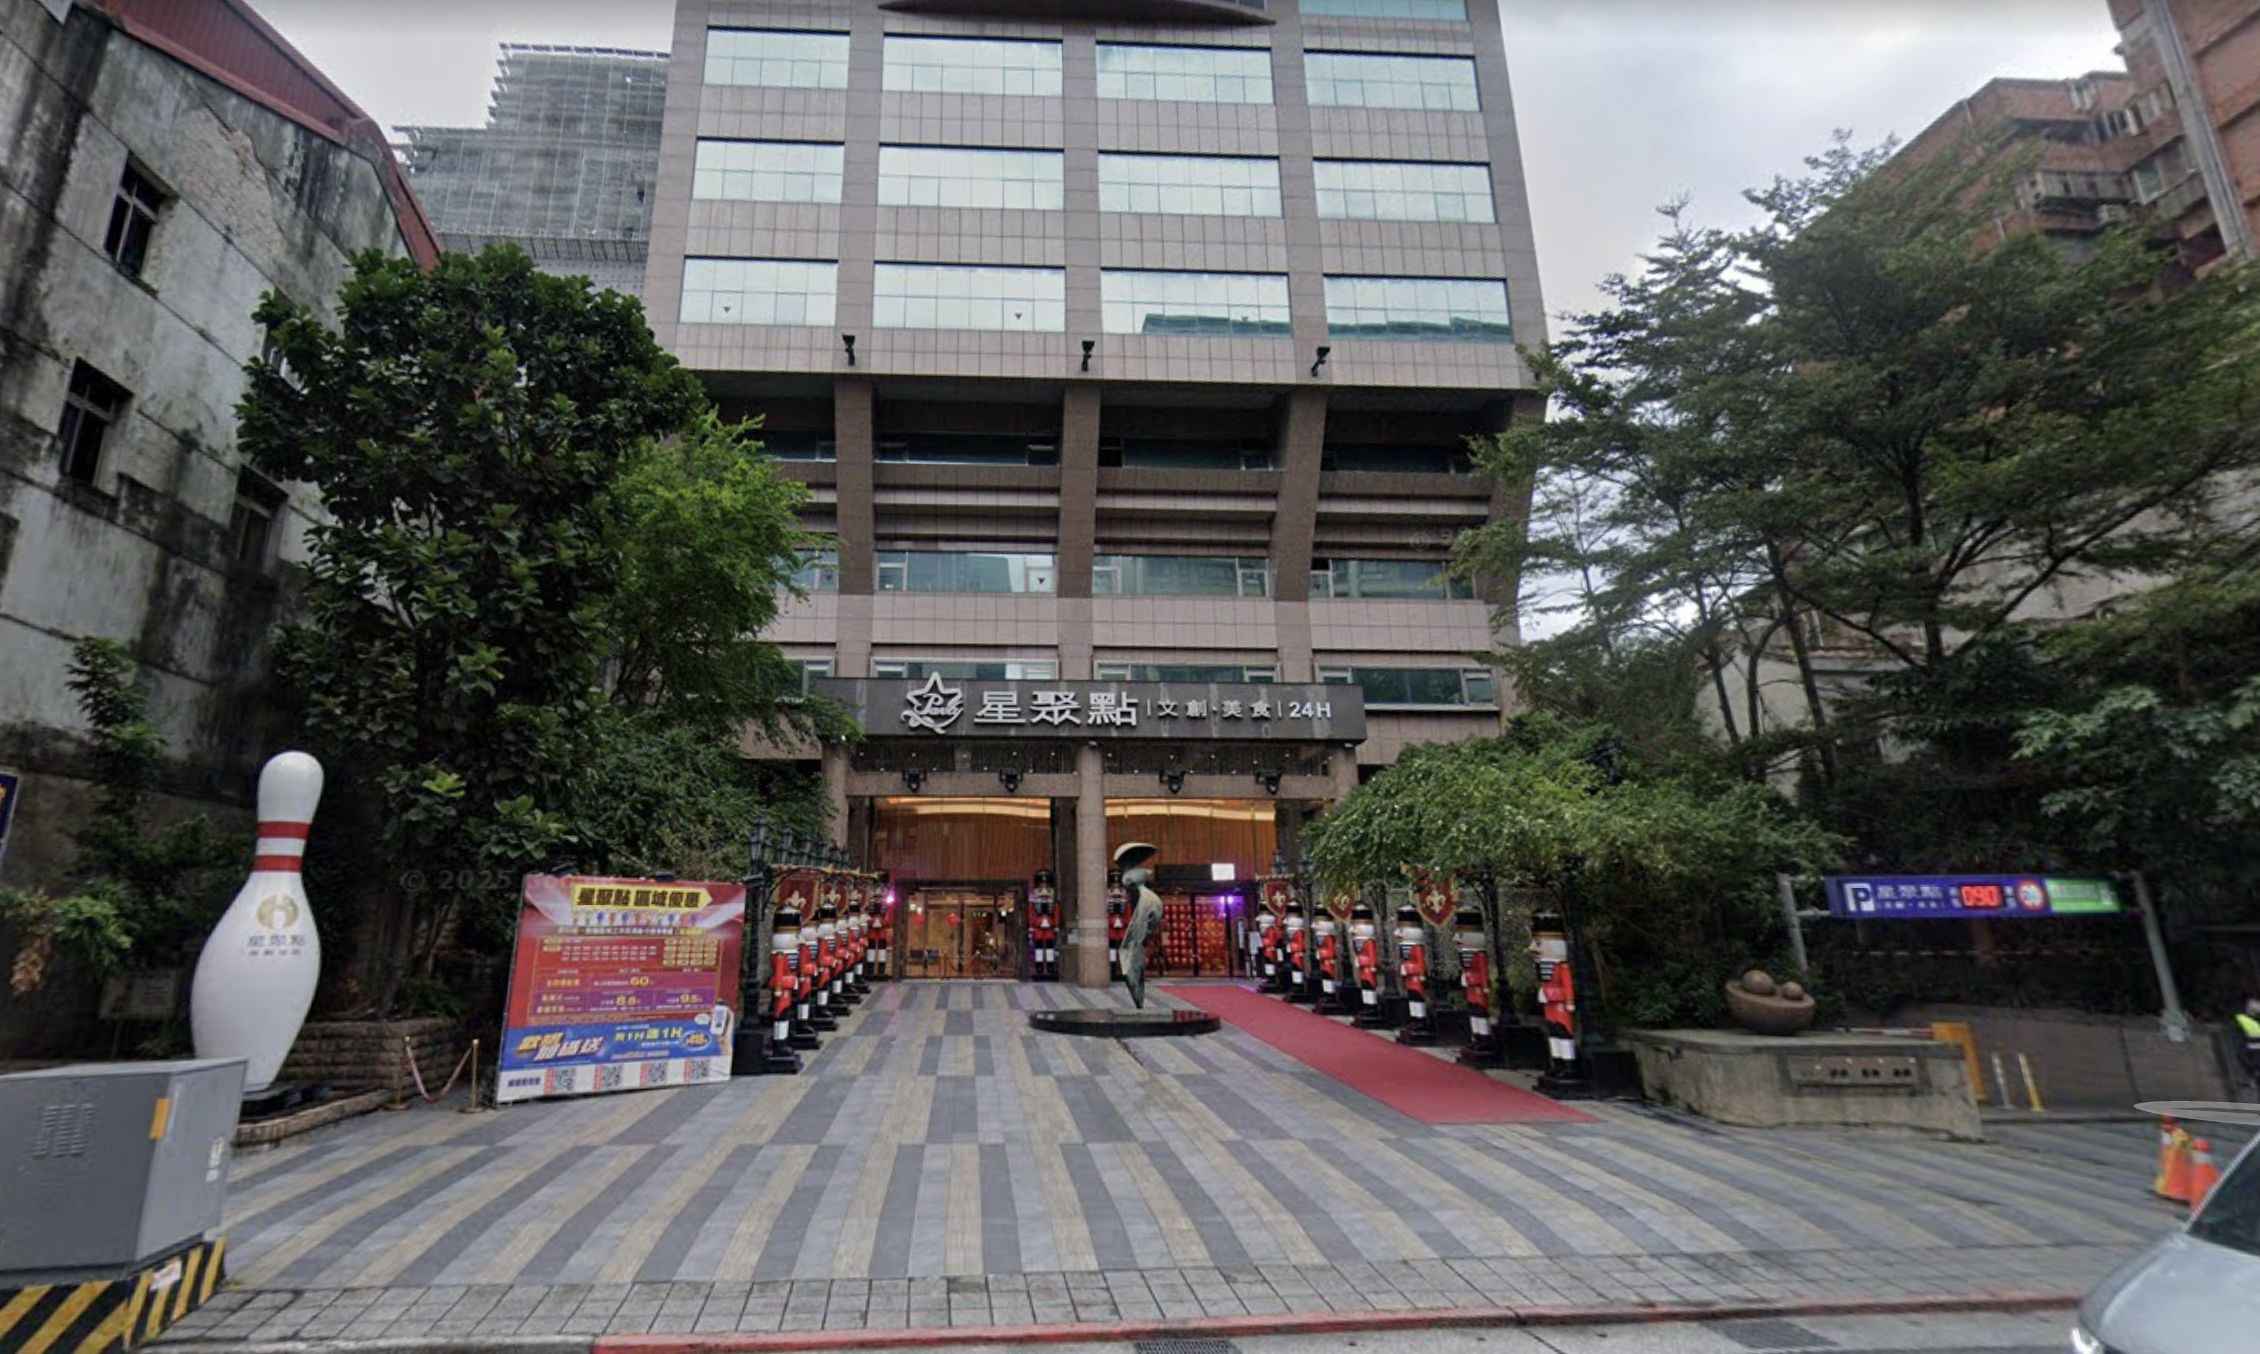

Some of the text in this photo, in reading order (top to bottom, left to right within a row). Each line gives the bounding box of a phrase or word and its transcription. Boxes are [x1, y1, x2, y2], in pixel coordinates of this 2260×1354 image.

[974, 691, 1139, 727] 星聚點
[1289, 701, 1333, 720] 24H
[1961, 886, 1998, 905] 090
